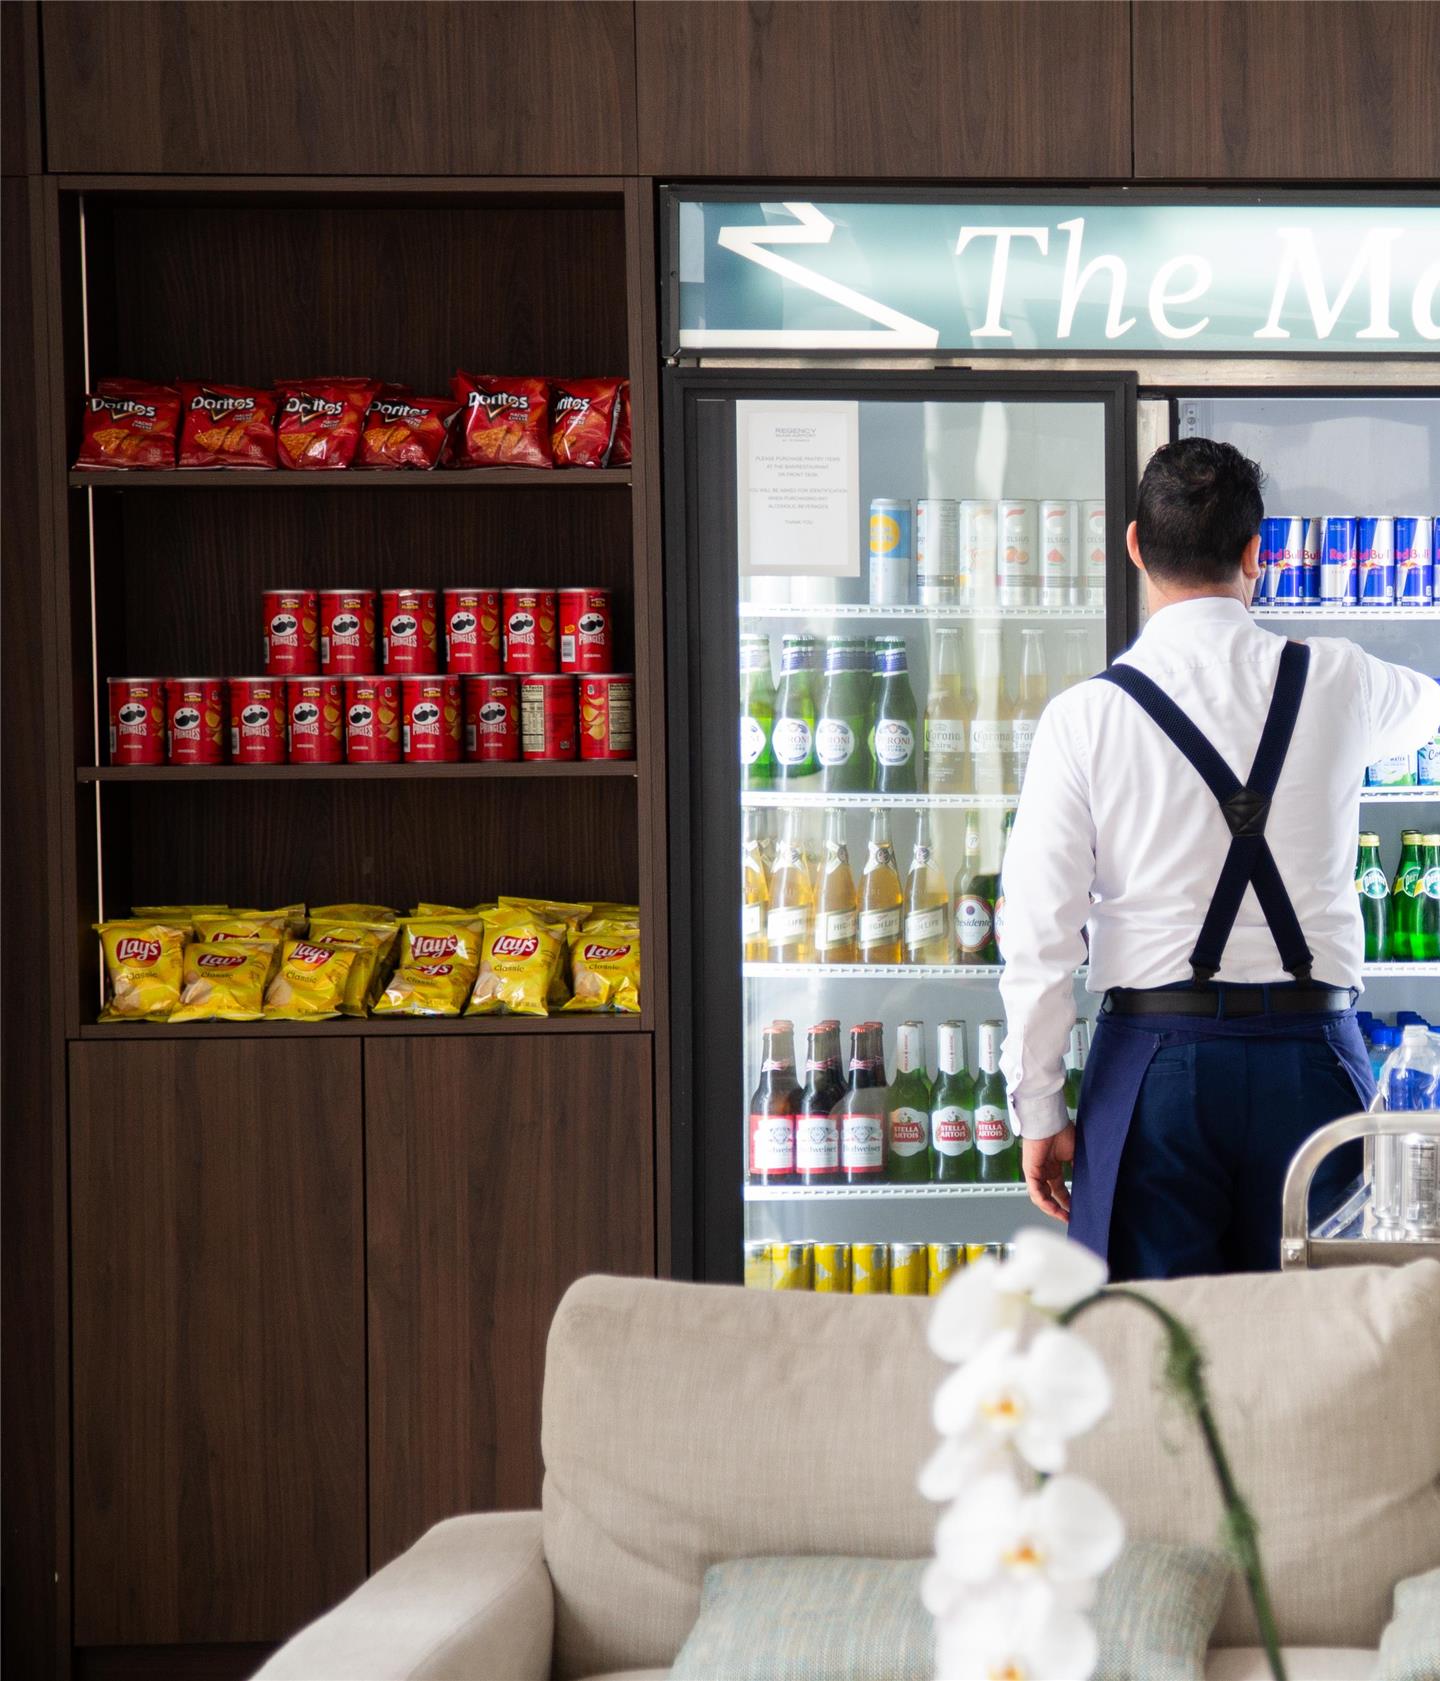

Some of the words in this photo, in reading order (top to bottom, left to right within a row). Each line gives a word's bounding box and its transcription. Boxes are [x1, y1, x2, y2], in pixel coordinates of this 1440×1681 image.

[954, 217, 1213, 340] The
[192, 396, 254, 410] Doritos
[286, 398, 342, 415] Doritos
[469, 392, 528, 409] Doritos
[557, 396, 590, 411] ritos
[92, 398, 156, 417] Doritos
[271, 634, 298, 647] PRINGLES
[332, 634, 360, 647] PRINGLES
[391, 635, 417, 648] PRINGLES
[451, 632, 477, 645] PRINGLES
[509, 632, 535, 645] PRINGLES
[578, 633, 605, 645] PRINGLES
[119, 723, 147, 736] PRINGLES
[174, 728, 200, 741] PRINGLES
[242, 724, 270, 737] PRINGLES
[293, 722, 319, 735] PRINGLES
[349, 725, 373, 737] PRINGLES
[413, 723, 439, 736] PRINGLES
[480, 722, 507, 735] PRINGLES
[120, 938, 161, 961] Lay's
[293, 943, 330, 962] Lay's
[414, 936, 458, 958] Lay's
[494, 937, 538, 956] Lay's
[494, 964, 524, 973] Classic
[286, 971, 318, 984] Classic
